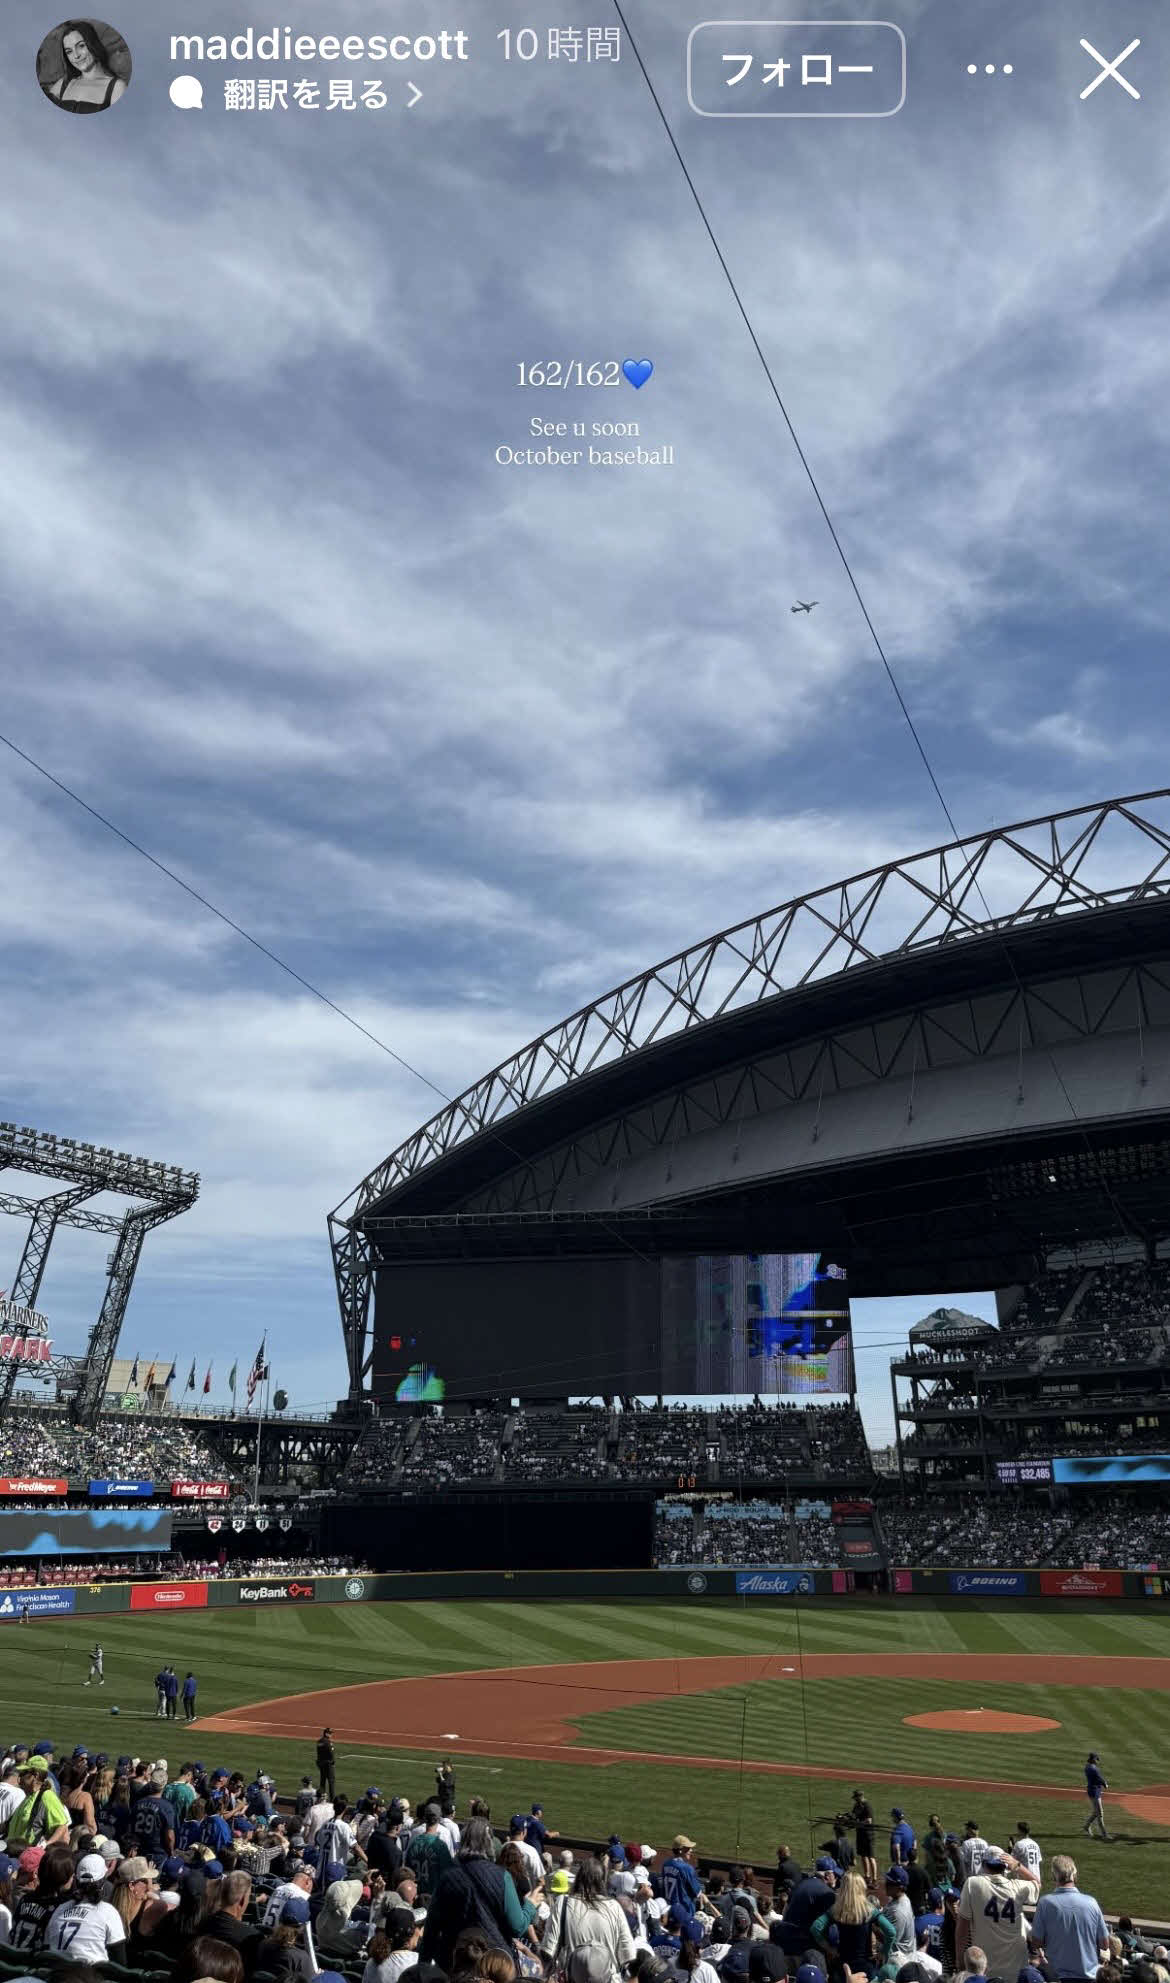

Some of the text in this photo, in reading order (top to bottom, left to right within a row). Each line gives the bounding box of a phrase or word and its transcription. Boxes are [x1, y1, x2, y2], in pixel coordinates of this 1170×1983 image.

[0, 1301, 49, 1333] MARINERS
[919, 1327, 980, 1339] MUCKLESHOOT
[0, 1335, 54, 1361] PARK
[740, 1576, 788, 1593] Alaska
[970, 1577, 1017, 1586] BOEING
[16, 1593, 60, 1604] Virginia Mason
[240, 1583, 288, 1601] KeyBank
[48, 1601, 70, 1609] Health
[1028, 1851, 1038, 1865] 51
[20, 1902, 47, 1920] OHTANI
[63, 1908, 90, 1919] OHTANI
[265, 1904, 280, 1927] 5
[984, 1895, 1016, 1924] 44
[15, 1919, 40, 1949] 17
[57, 1921, 82, 1950] 17
